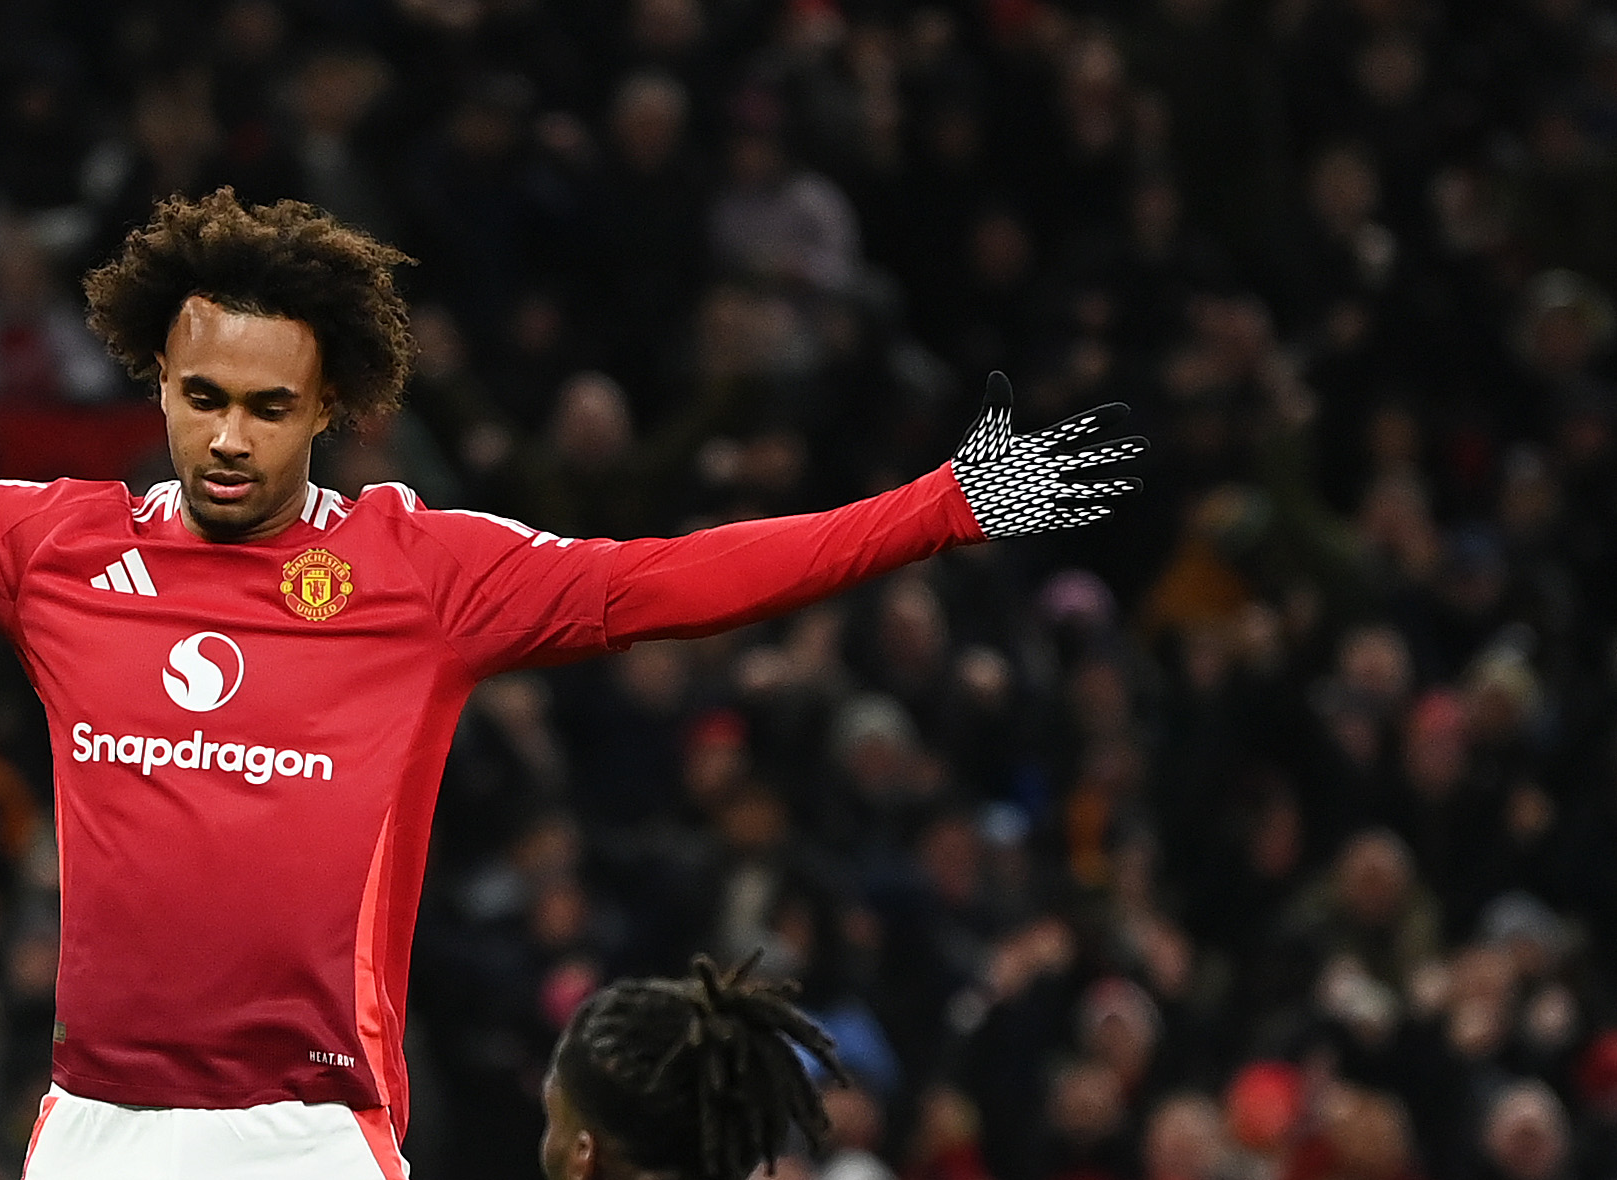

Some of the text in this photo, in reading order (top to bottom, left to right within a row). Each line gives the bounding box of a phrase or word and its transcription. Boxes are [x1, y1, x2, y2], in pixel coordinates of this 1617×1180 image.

[288, 554, 346, 577] MANCHESTER
[297, 603, 337, 617] UNITED
[72, 722, 333, 784] Snapdragon
[309, 1050, 355, 1068] HEAT.RDY
